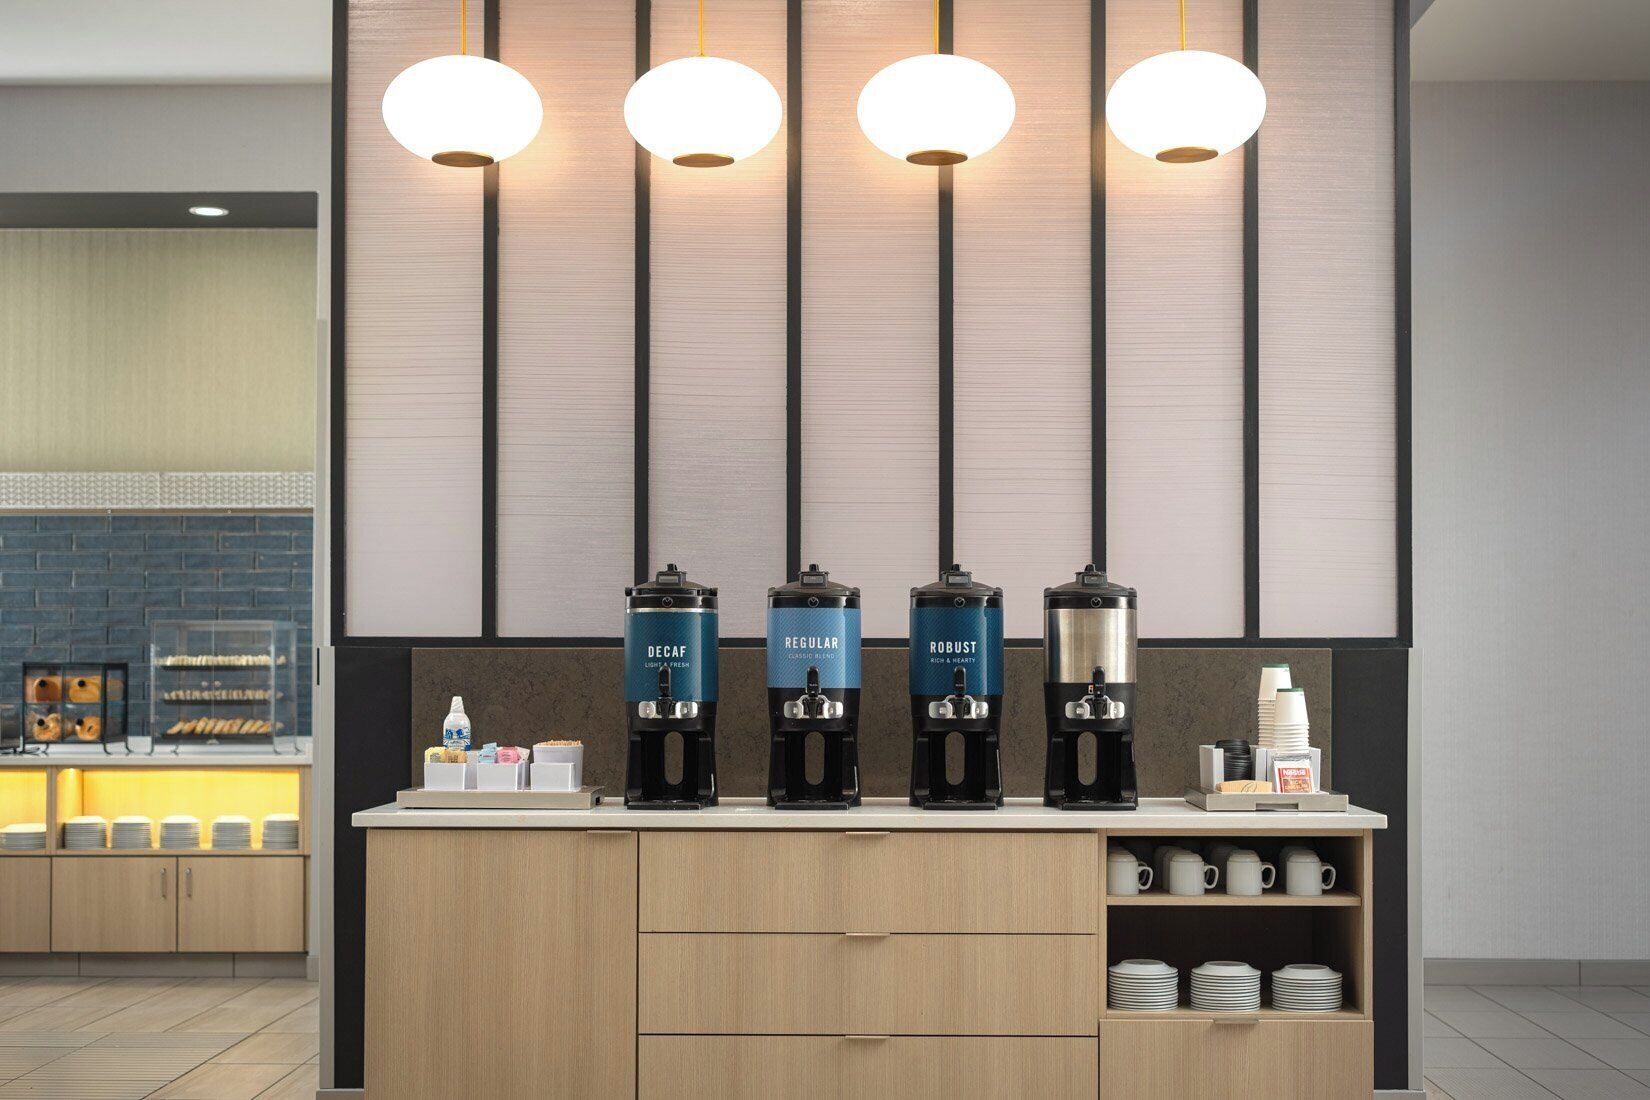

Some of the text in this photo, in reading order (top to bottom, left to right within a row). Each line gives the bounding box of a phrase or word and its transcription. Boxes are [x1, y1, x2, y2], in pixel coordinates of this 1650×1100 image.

[785, 637, 838, 649] REGULAR
[930, 641, 977, 653] ROBUST
[648, 645, 687, 658] DECAF
